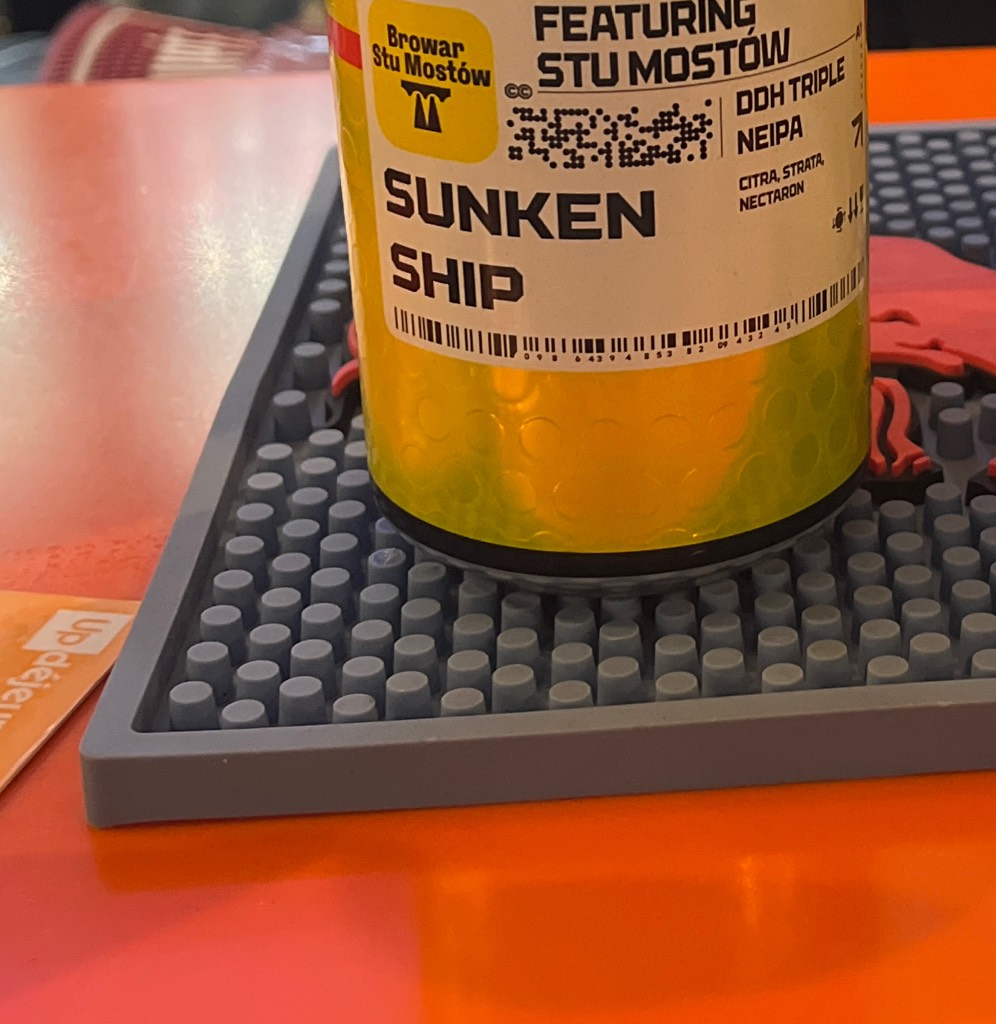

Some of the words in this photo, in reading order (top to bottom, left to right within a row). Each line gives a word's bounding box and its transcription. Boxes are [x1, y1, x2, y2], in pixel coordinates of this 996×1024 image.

[386, 24, 465, 59] Browar
[537, 51, 620, 87] STU
[628, 26, 791, 86] MOSTÓW
[372, 43, 401, 72] Stu
[404, 52, 492, 87] Mostów
[736, 81, 785, 116] DDH
[788, 56, 846, 102] TRIPLE
[737, 114, 804, 155] NEIPA
[739, 167, 781, 192] CITRA,
[782, 152, 825, 180] STRATA,
[384, 167, 656, 240] SUNKEN
[739, 180, 805, 212] NECTARON
[390, 241, 525, 311] SHIP
